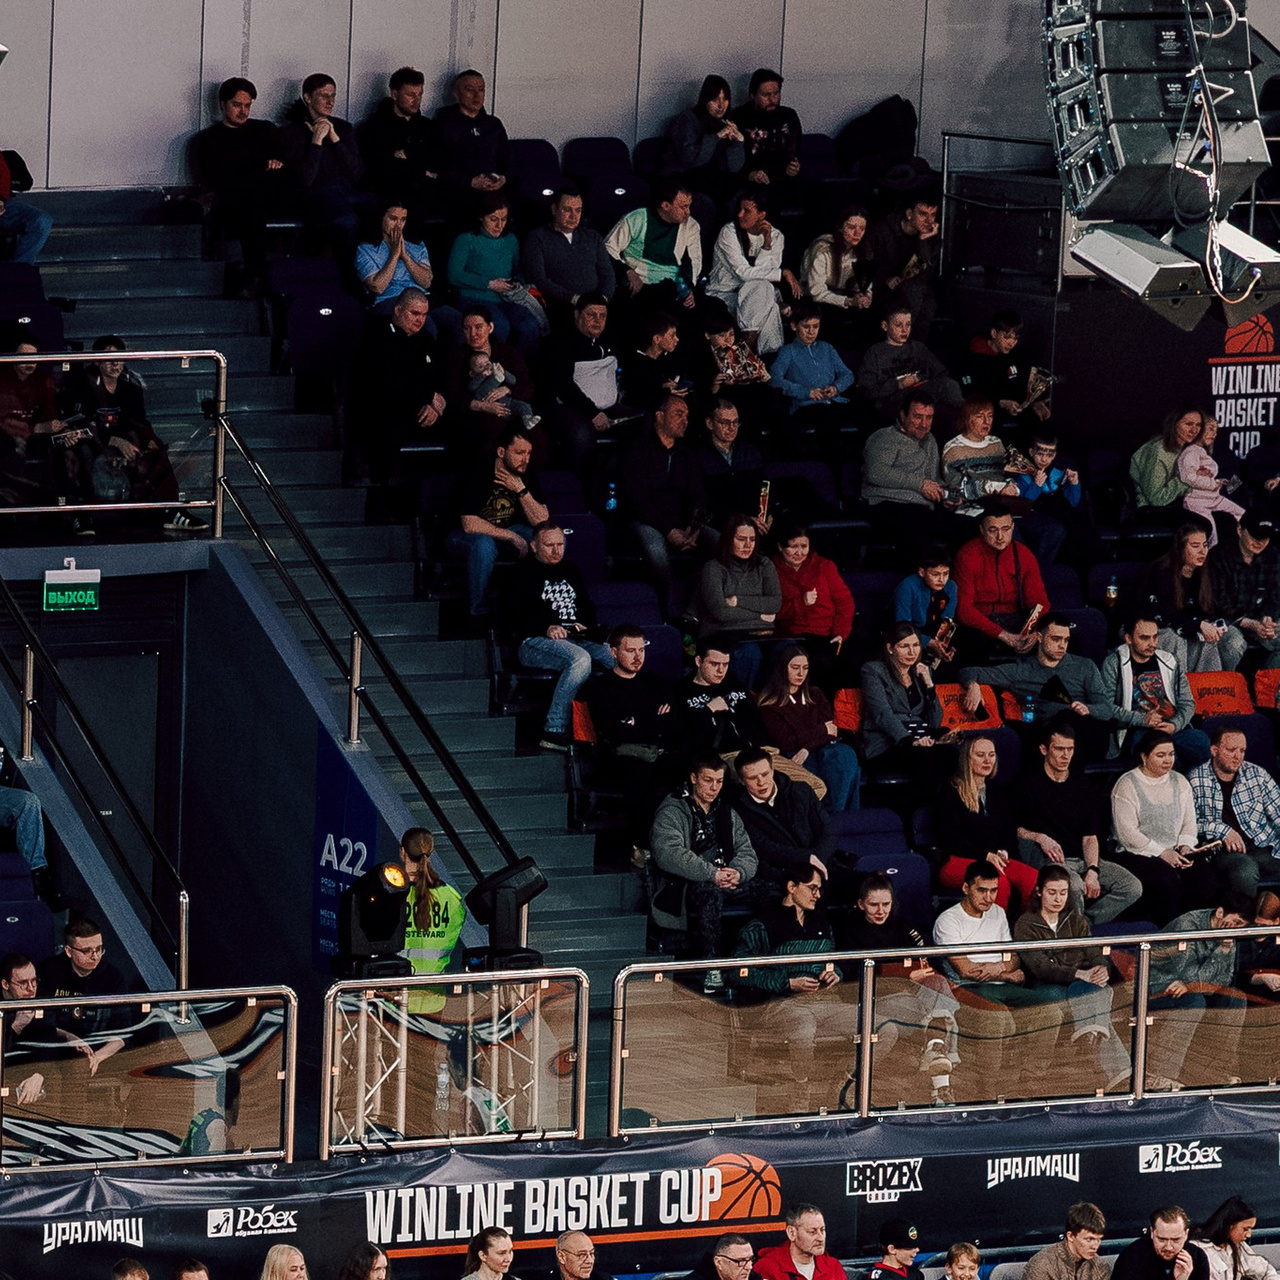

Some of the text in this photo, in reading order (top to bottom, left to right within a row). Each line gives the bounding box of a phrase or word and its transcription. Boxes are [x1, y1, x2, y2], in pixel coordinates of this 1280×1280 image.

[1215, 398, 1277, 428] BASKET
[1229, 431, 1261, 460] CUP
[48, 590, 96, 605] ВЫХОД
[405, 930, 446, 939] STEWARD
[1165, 1142, 1222, 1167] Робек
[846, 1157, 923, 1196] BROZEX
[986, 1153, 1080, 1189] УРАЛМАШ
[236, 1205, 298, 1230] Робек
[365, 1168, 722, 1244] WINLINE BASKET CUP
[42, 1218, 144, 1254] УРАЛМАШ
